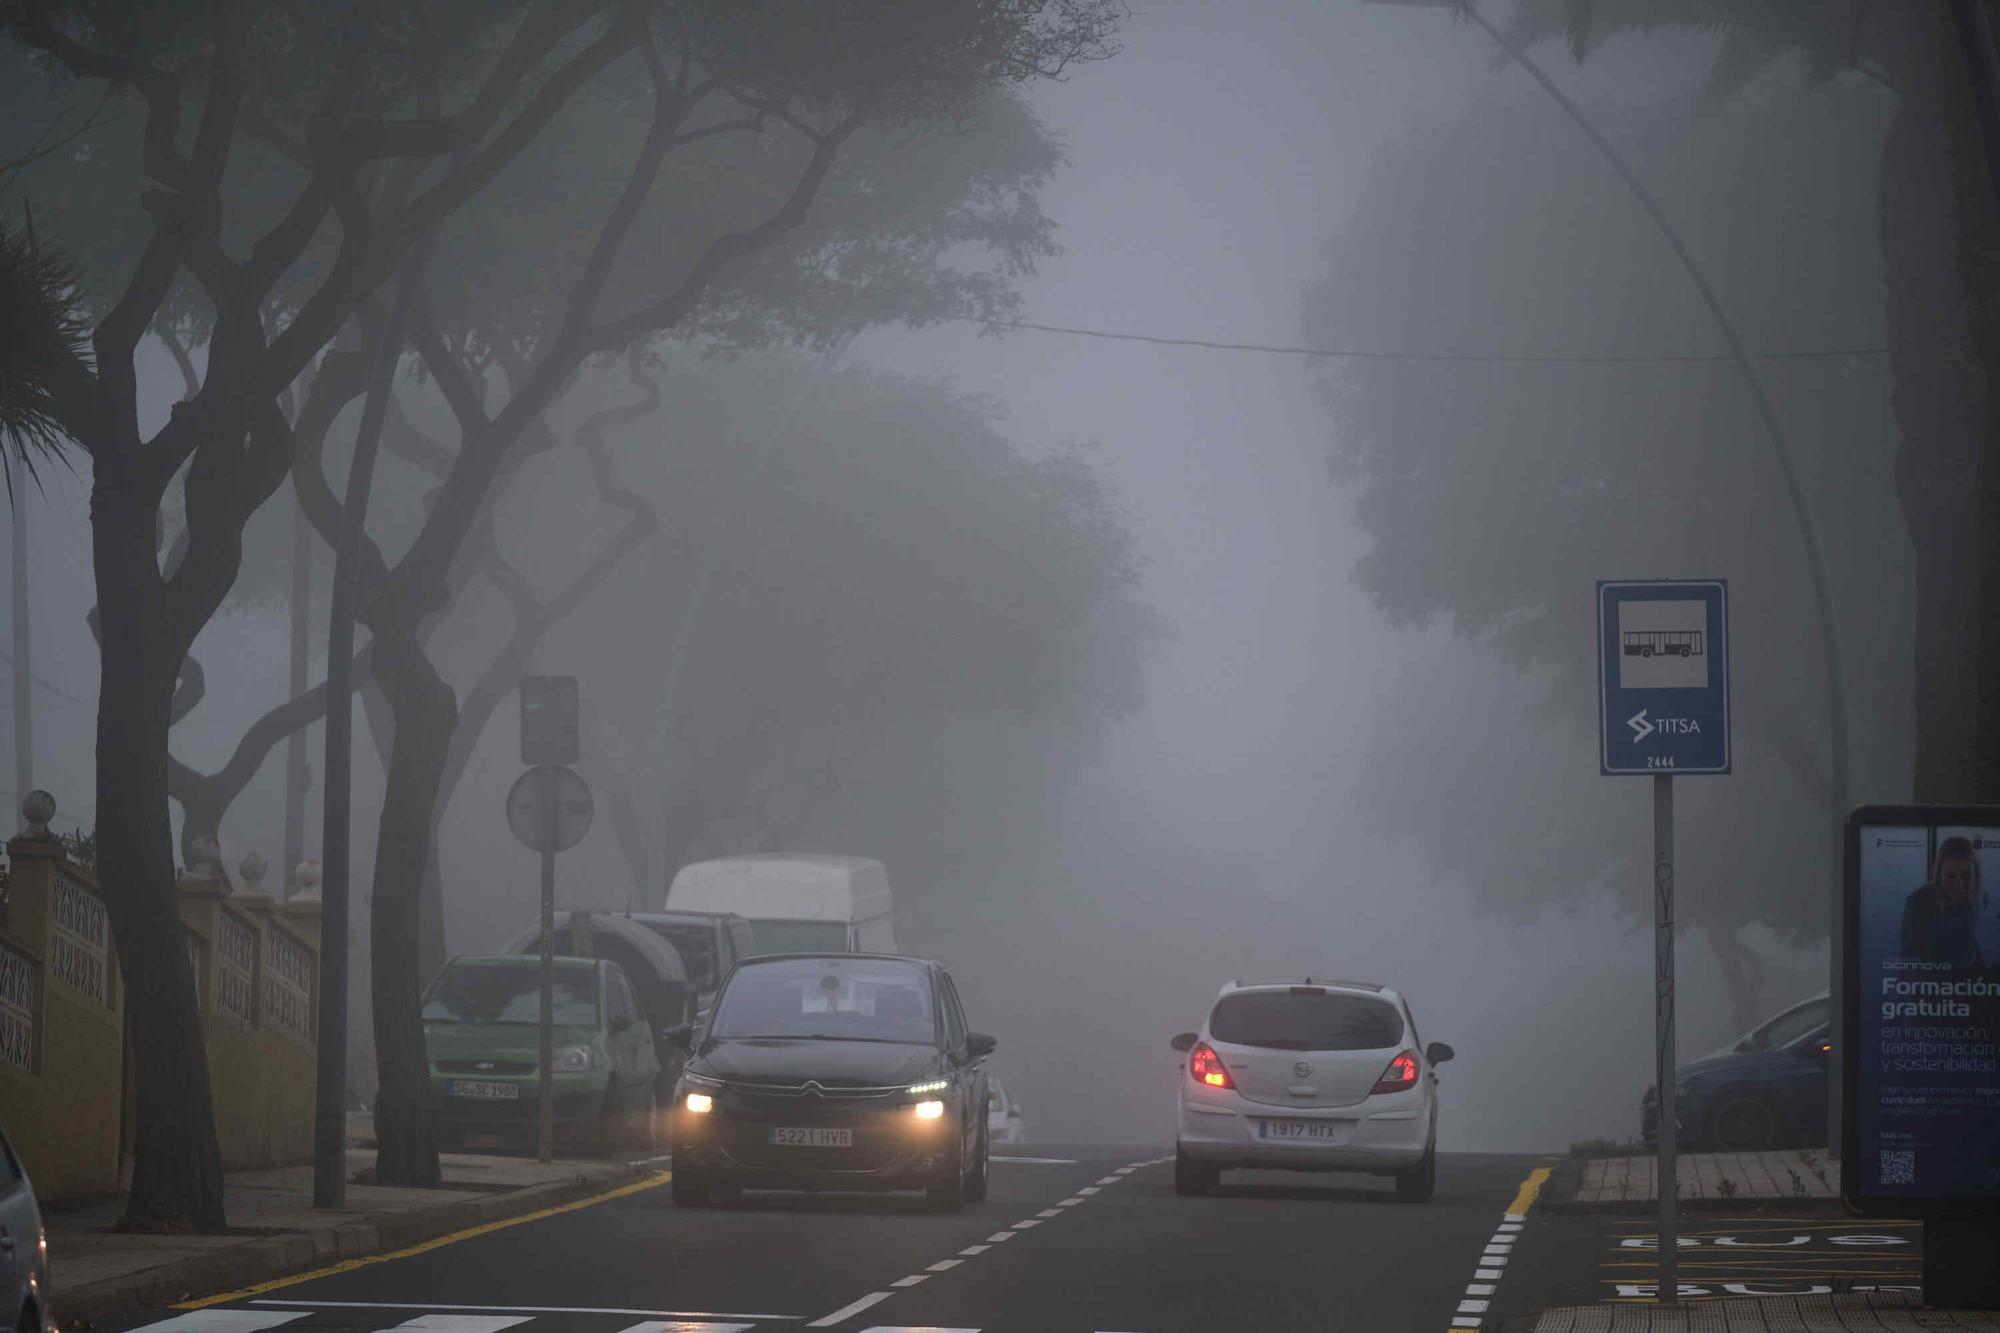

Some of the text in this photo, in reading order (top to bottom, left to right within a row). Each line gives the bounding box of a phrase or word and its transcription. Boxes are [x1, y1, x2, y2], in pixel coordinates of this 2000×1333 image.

[1655, 717, 1701, 734] TITSA
[1647, 756, 1675, 768] 2444
[1882, 976, 2000, 996] Formación
[1881, 999, 1971, 1019] gratuita
[1881, 1026, 1900, 1039] en
[1881, 1057, 1996, 1072] y sostenibilidad
[778, 1129, 849, 1144] 5221 HVR
[1272, 1123, 1335, 1137] 1917 HTX
[1619, 1234, 1912, 1248] BUS
